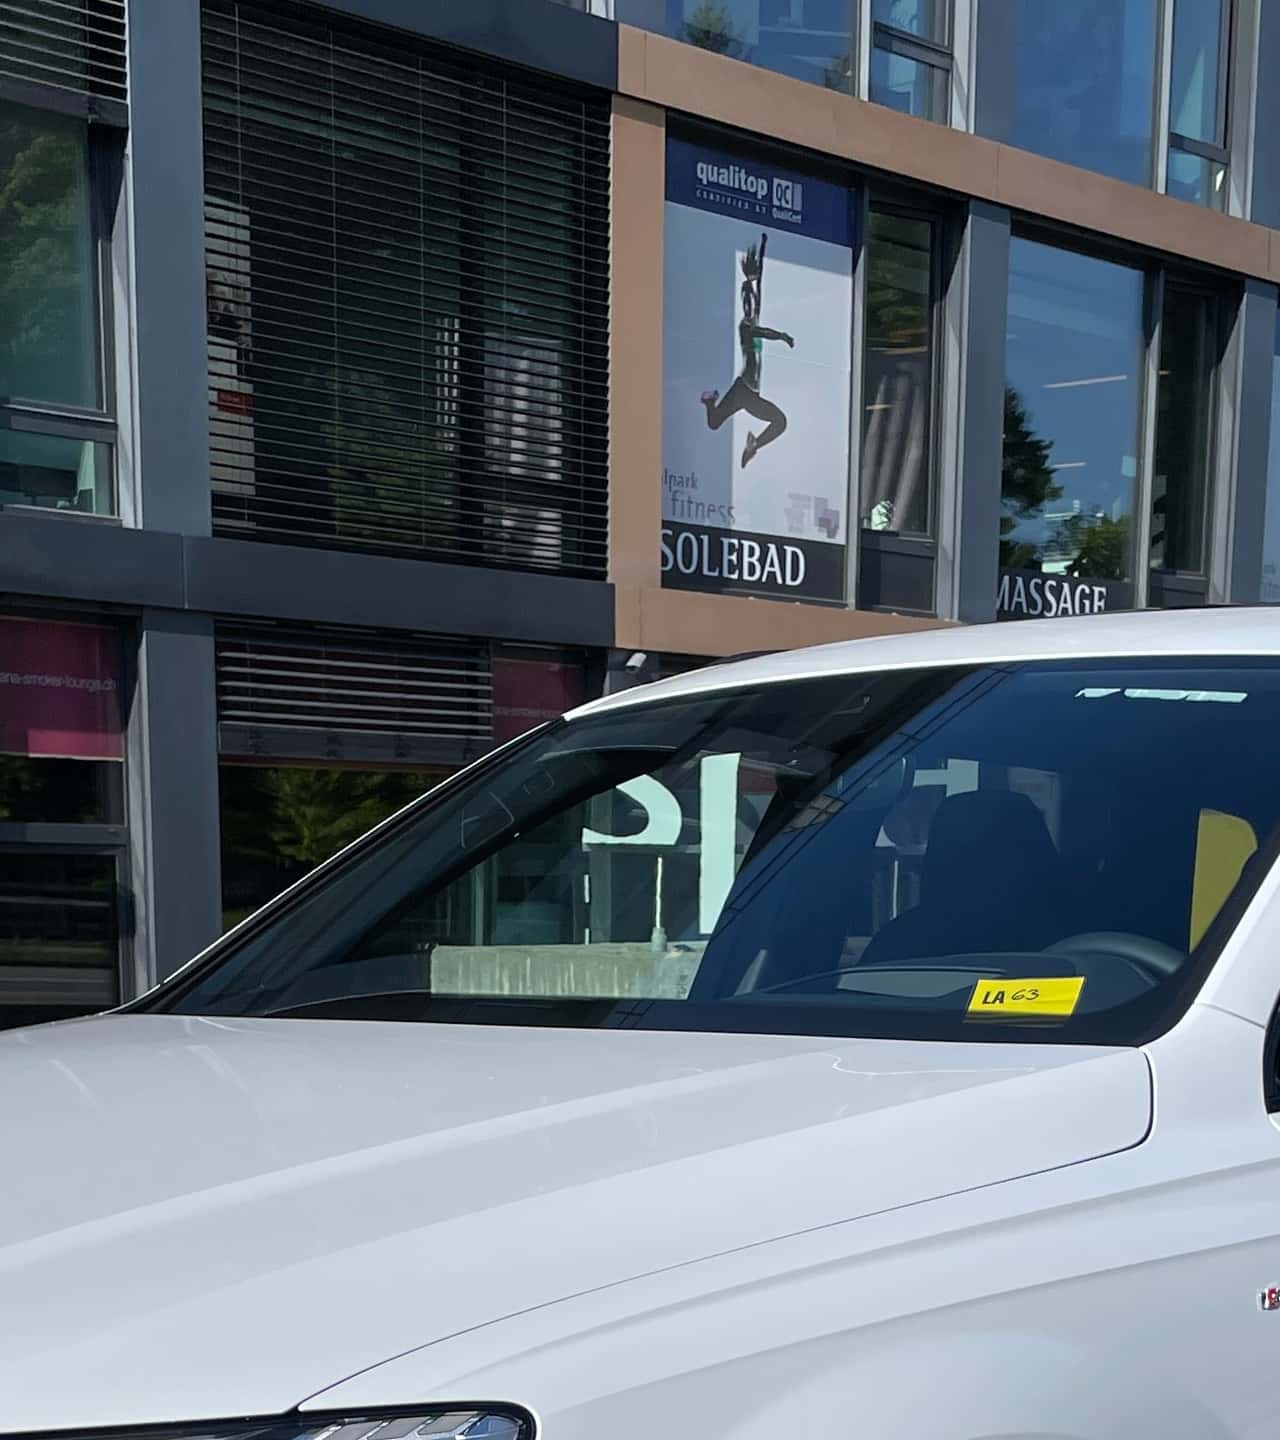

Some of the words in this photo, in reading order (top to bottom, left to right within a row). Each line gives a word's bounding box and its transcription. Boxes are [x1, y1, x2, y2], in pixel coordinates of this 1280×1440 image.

[696, 161, 768, 199] qualitop
[672, 490, 735, 525] fitness
[660, 528, 805, 587] SOLEBAD
[982, 990, 1006, 1005] LA
[1011, 988, 1040, 1001] 63
